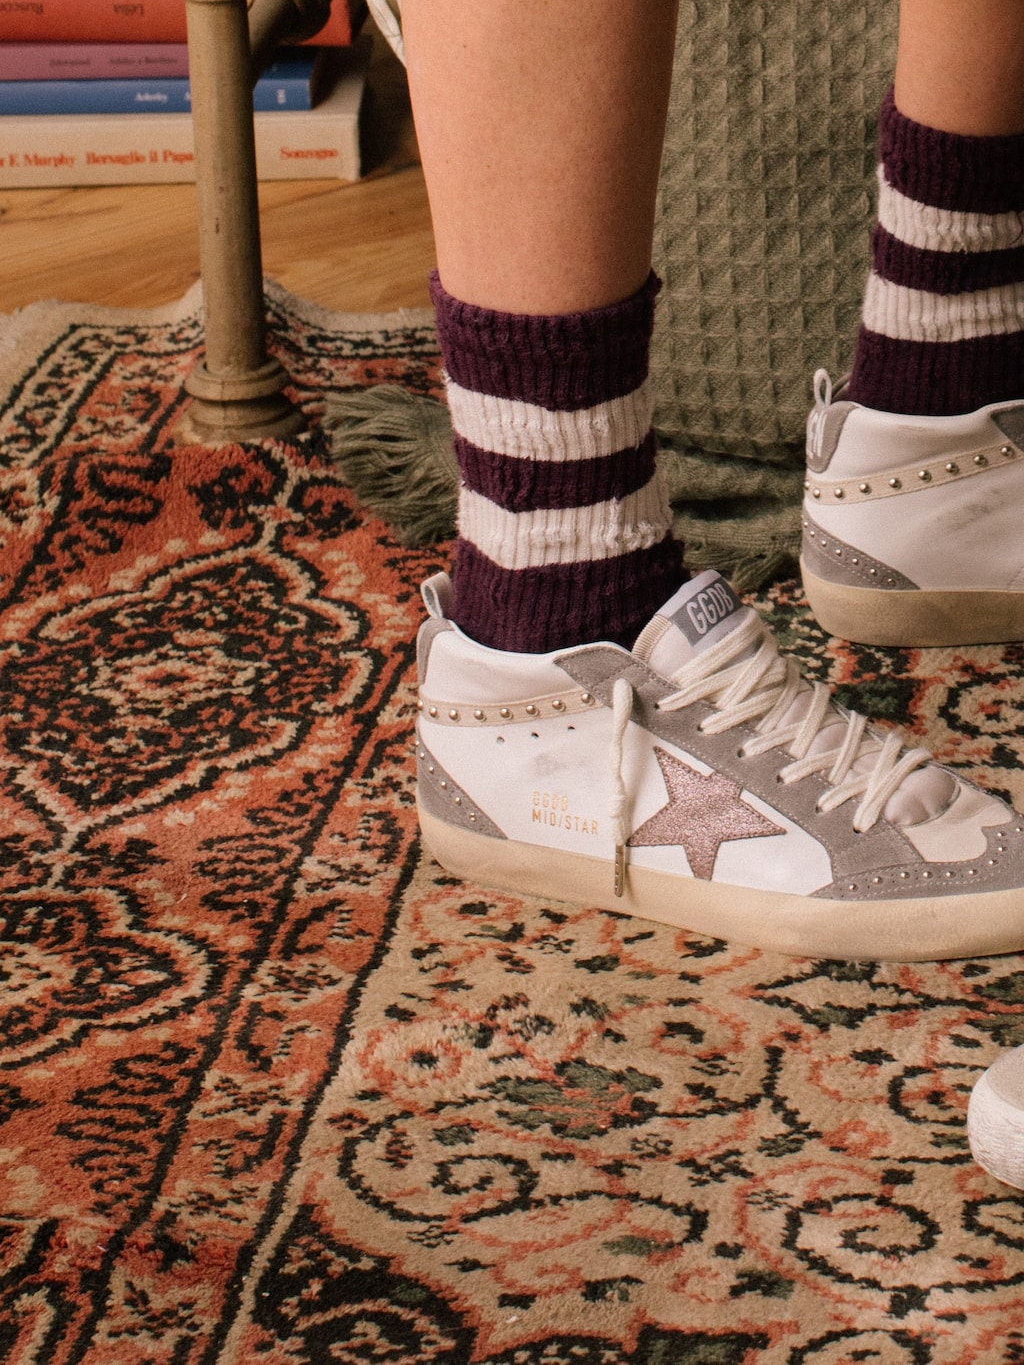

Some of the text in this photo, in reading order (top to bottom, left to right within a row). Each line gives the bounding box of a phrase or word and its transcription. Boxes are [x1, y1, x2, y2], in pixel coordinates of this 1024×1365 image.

[24, 153, 76, 169] Murphy
[686, 583, 734, 635] GGDB
[532, 809, 599, 835] MID/STAR
